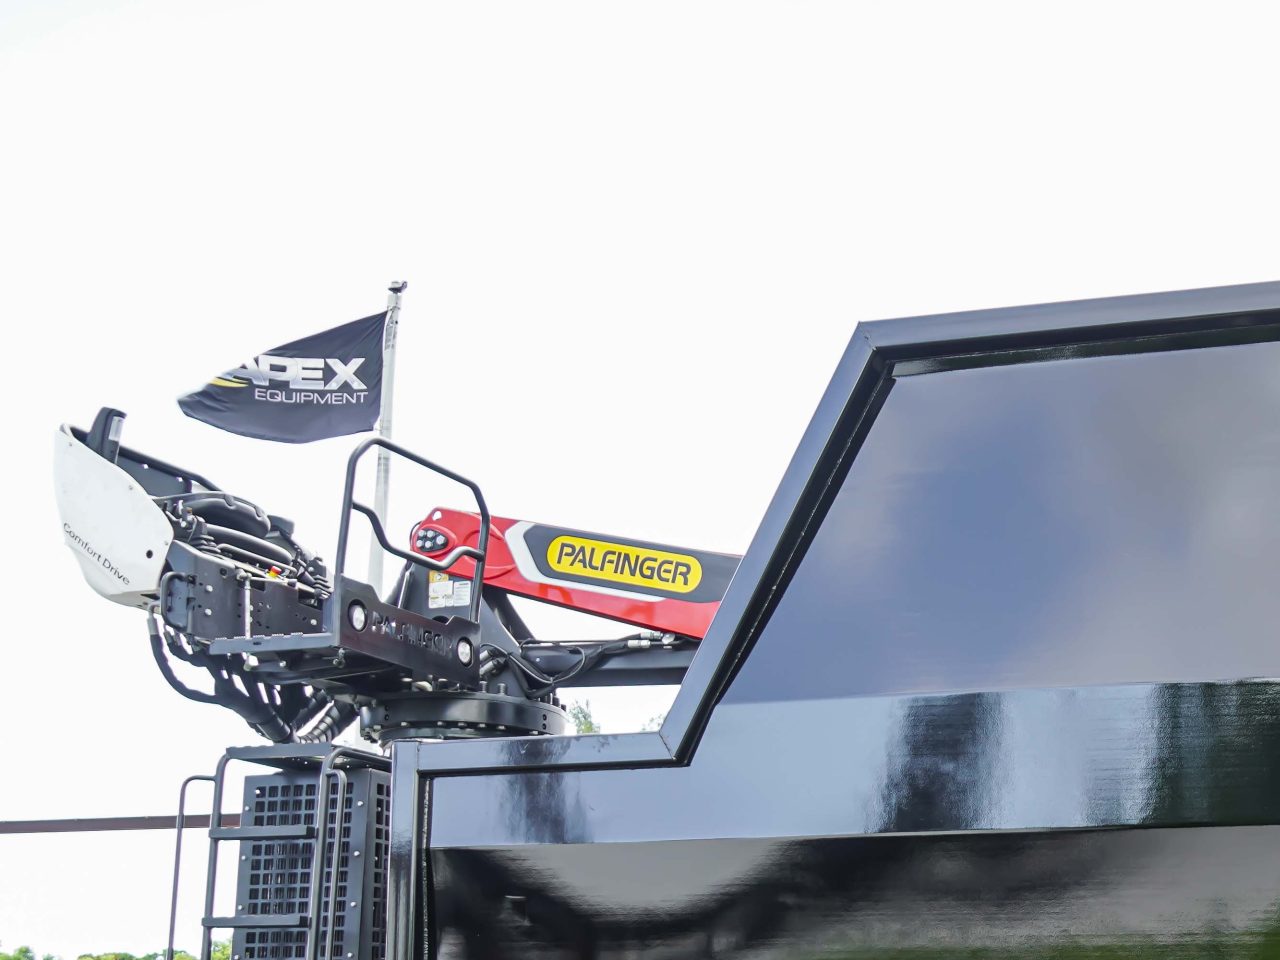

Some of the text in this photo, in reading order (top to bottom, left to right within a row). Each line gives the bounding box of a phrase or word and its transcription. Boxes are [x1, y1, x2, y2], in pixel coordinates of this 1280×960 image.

[228, 354, 368, 390] APEX
[254, 388, 368, 405] EQUIPMENT
[63, 522, 131, 585] Comfort Drive
[556, 542, 692, 586] PALFINGER
